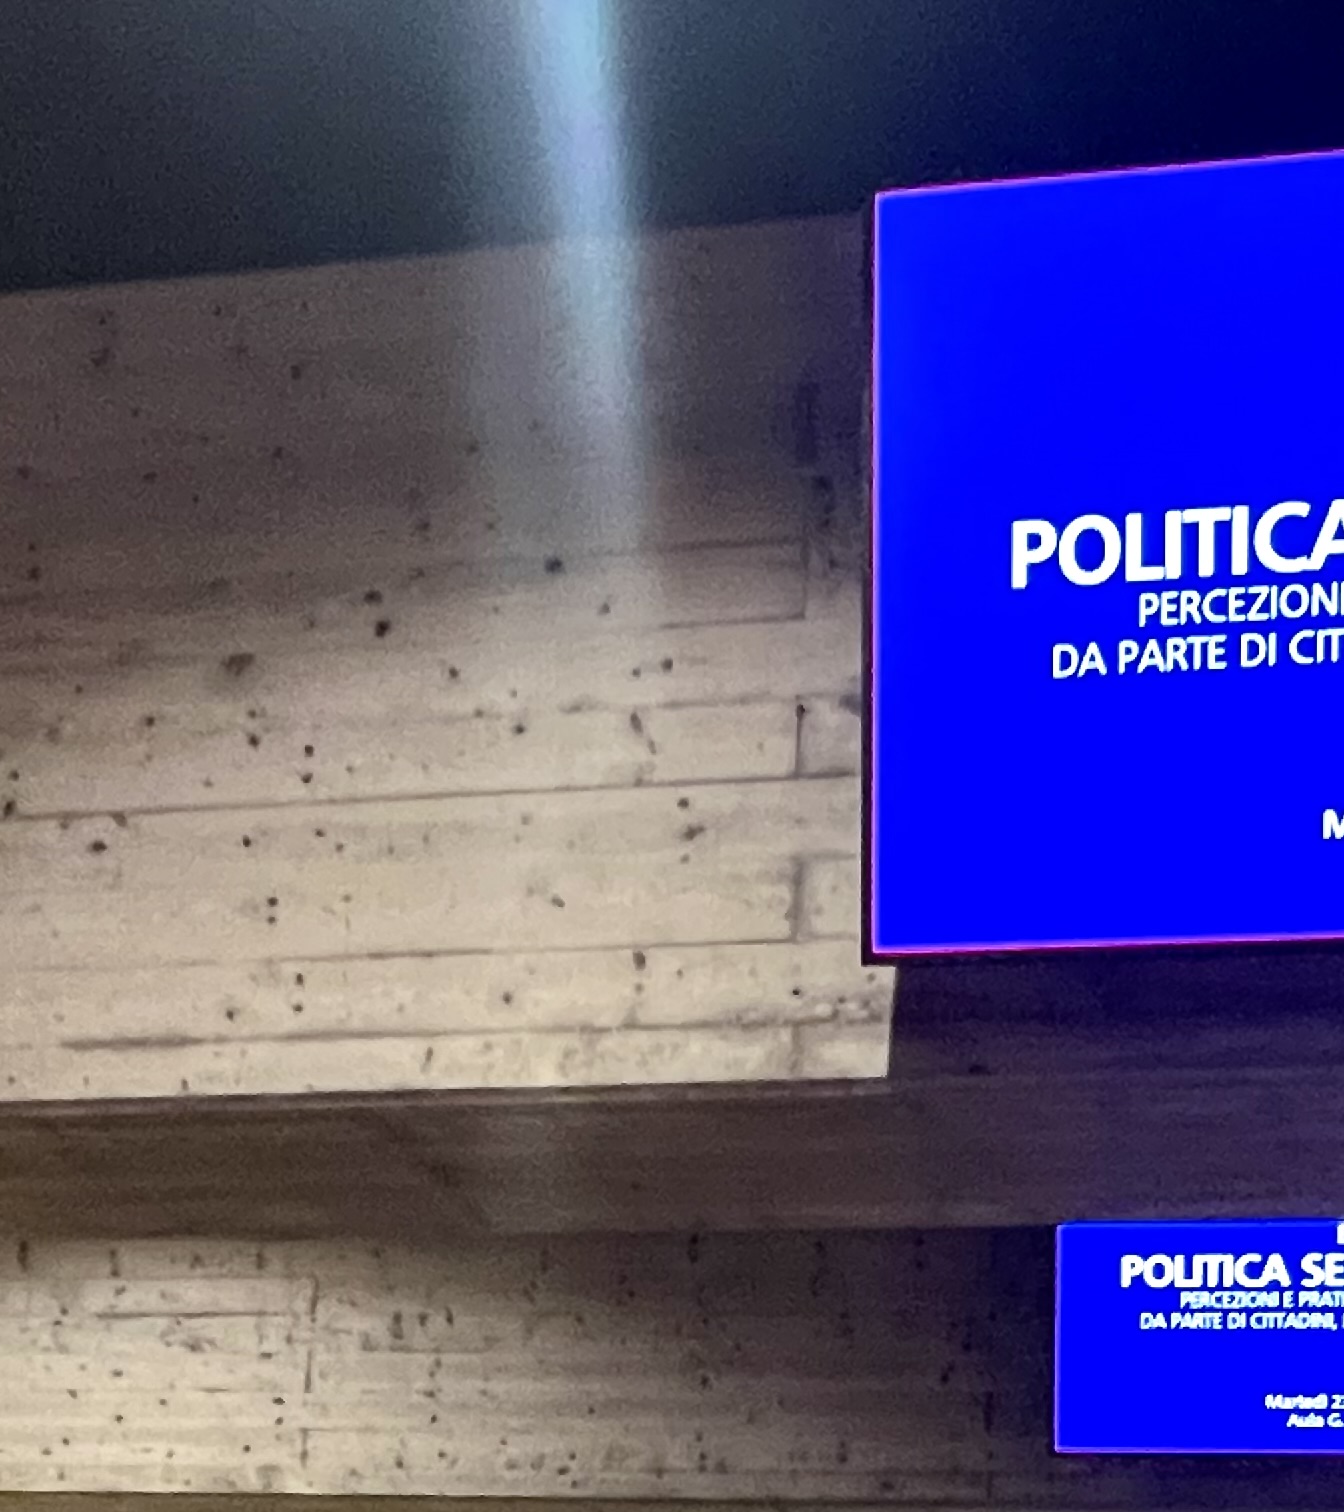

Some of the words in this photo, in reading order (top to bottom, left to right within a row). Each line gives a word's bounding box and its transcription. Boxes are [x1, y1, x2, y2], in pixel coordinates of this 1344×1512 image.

[1052, 641, 1108, 680] DA
[1118, 634, 1228, 675] PARTE
[1240, 632, 1278, 668] DI
[1120, 1252, 1292, 1288] POLITICA
[1282, 1290, 1296, 1308] E
[1140, 1312, 1168, 1330] DA
[1170, 1311, 1224, 1330] PARTE
[1226, 1312, 1247, 1330] DI
